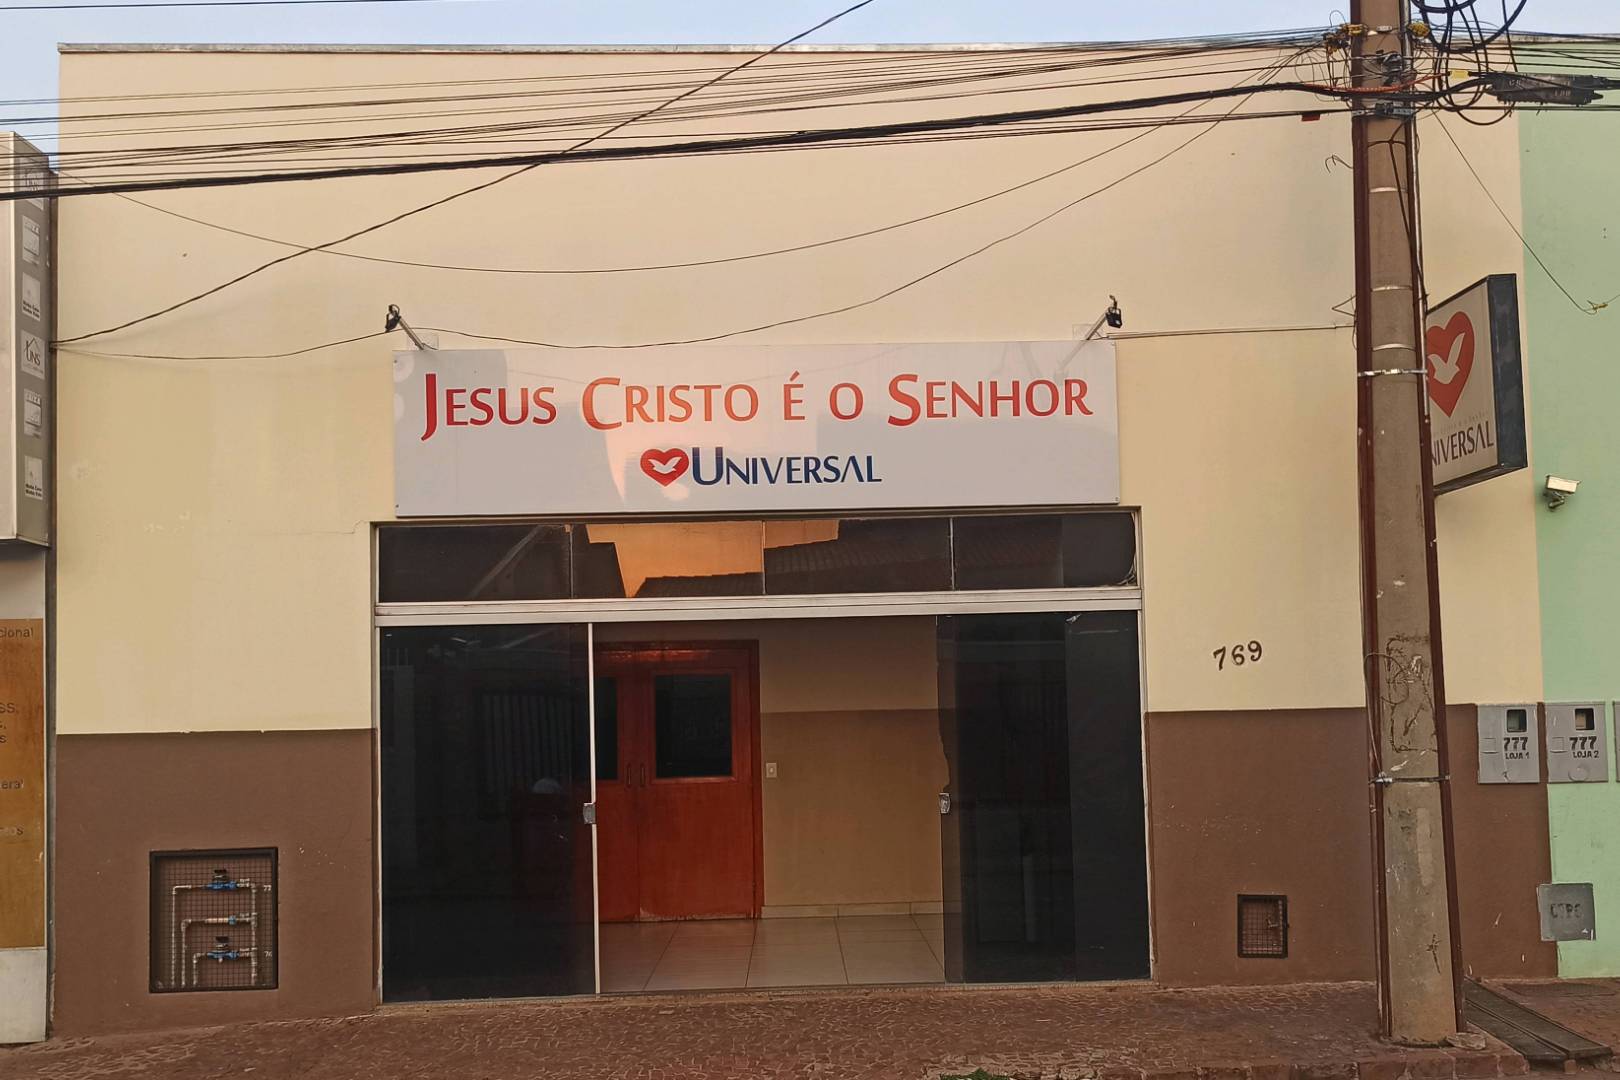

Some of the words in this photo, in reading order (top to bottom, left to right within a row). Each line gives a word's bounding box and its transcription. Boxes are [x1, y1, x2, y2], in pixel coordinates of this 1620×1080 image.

[783, 370, 806, 420] É
[829, 382, 864, 420] O
[692, 447, 883, 486] UNIVERSAL
[1213, 640, 1262, 671] 769
[1503, 738, 1528, 750] 777
[1569, 736, 1597, 750] 777
[1573, 751, 1593, 759] LOJA
